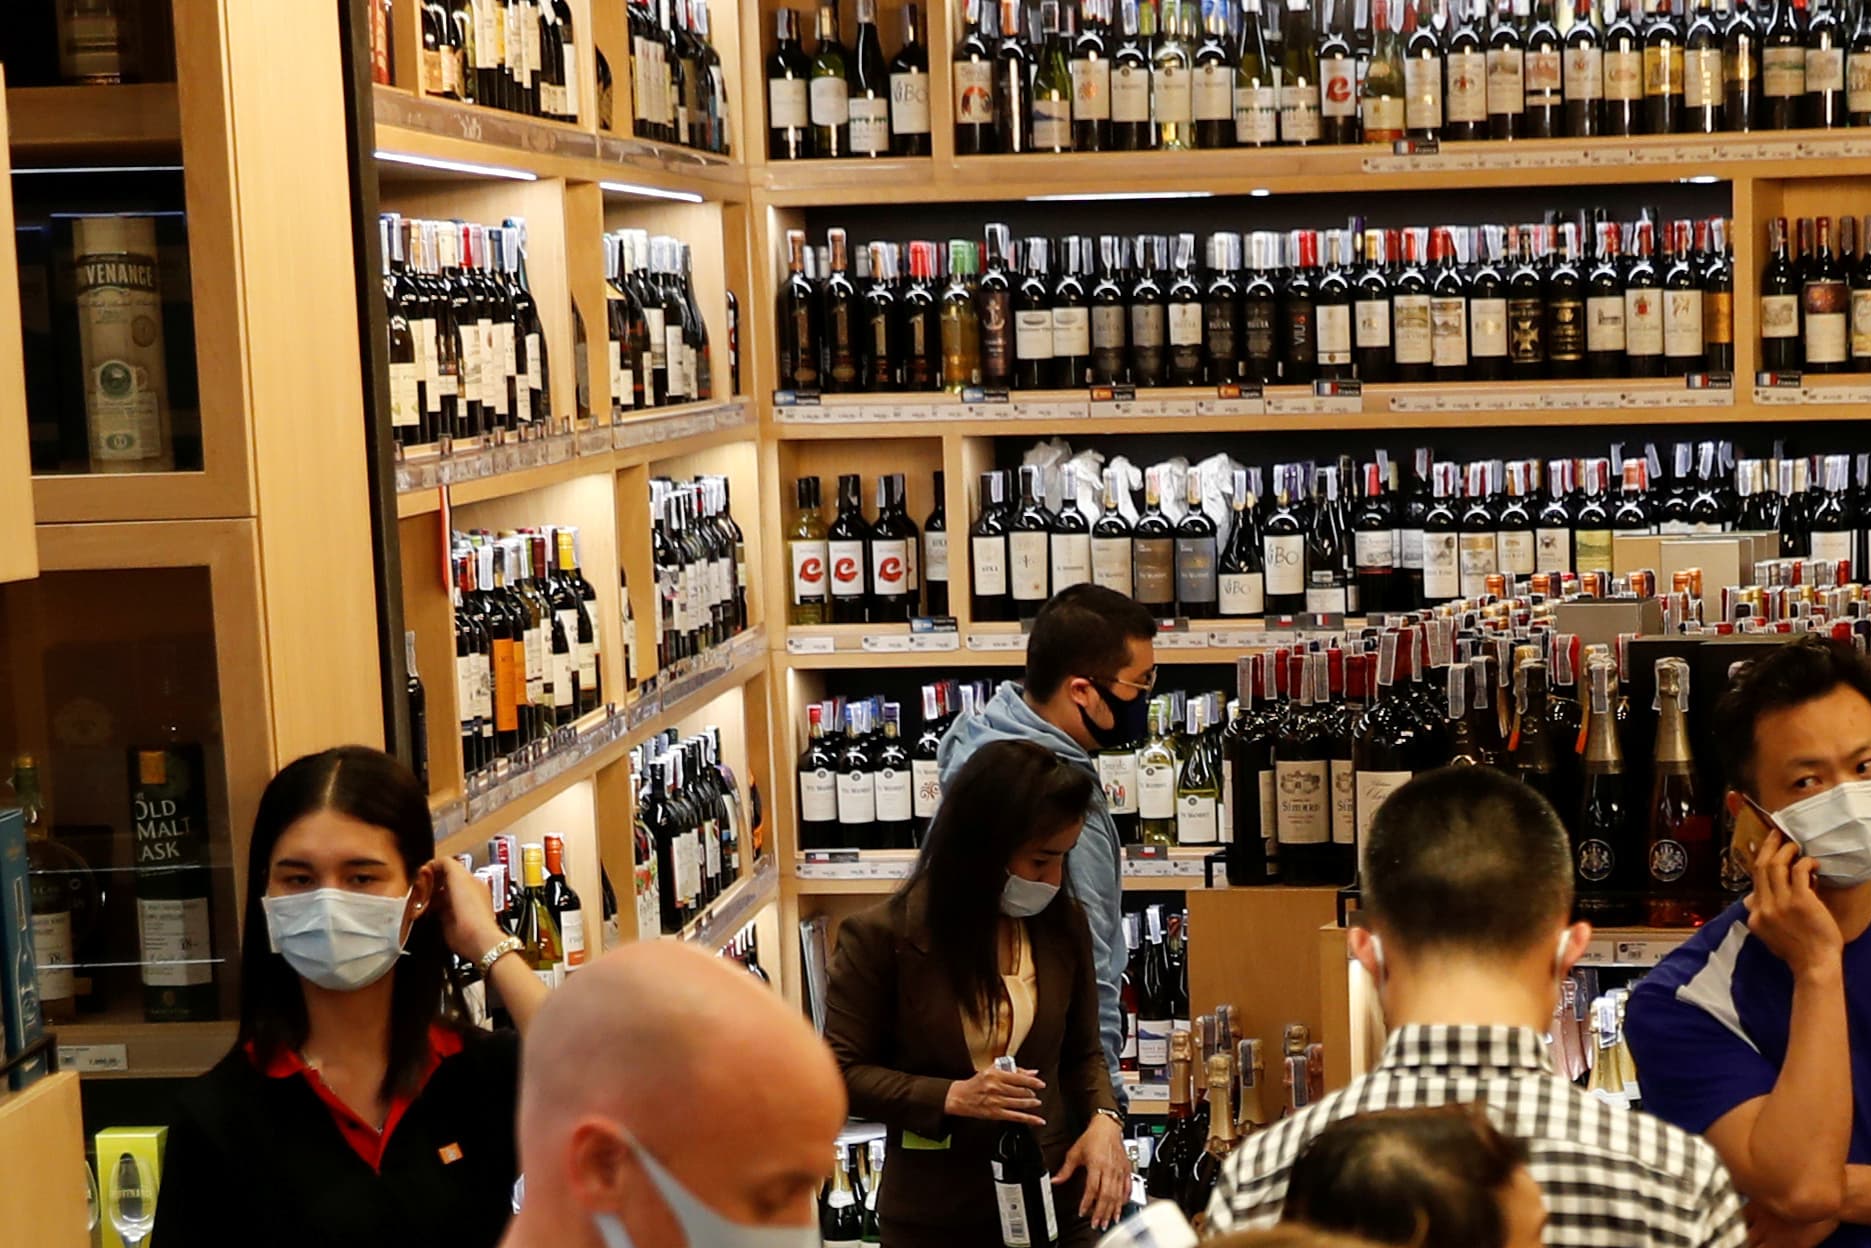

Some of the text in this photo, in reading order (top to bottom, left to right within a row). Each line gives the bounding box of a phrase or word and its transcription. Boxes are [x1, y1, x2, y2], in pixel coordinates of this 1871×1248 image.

[84, 263, 154, 287] VENANCE
[136, 816, 191, 841] MALT
[137, 841, 180, 862] ASK
